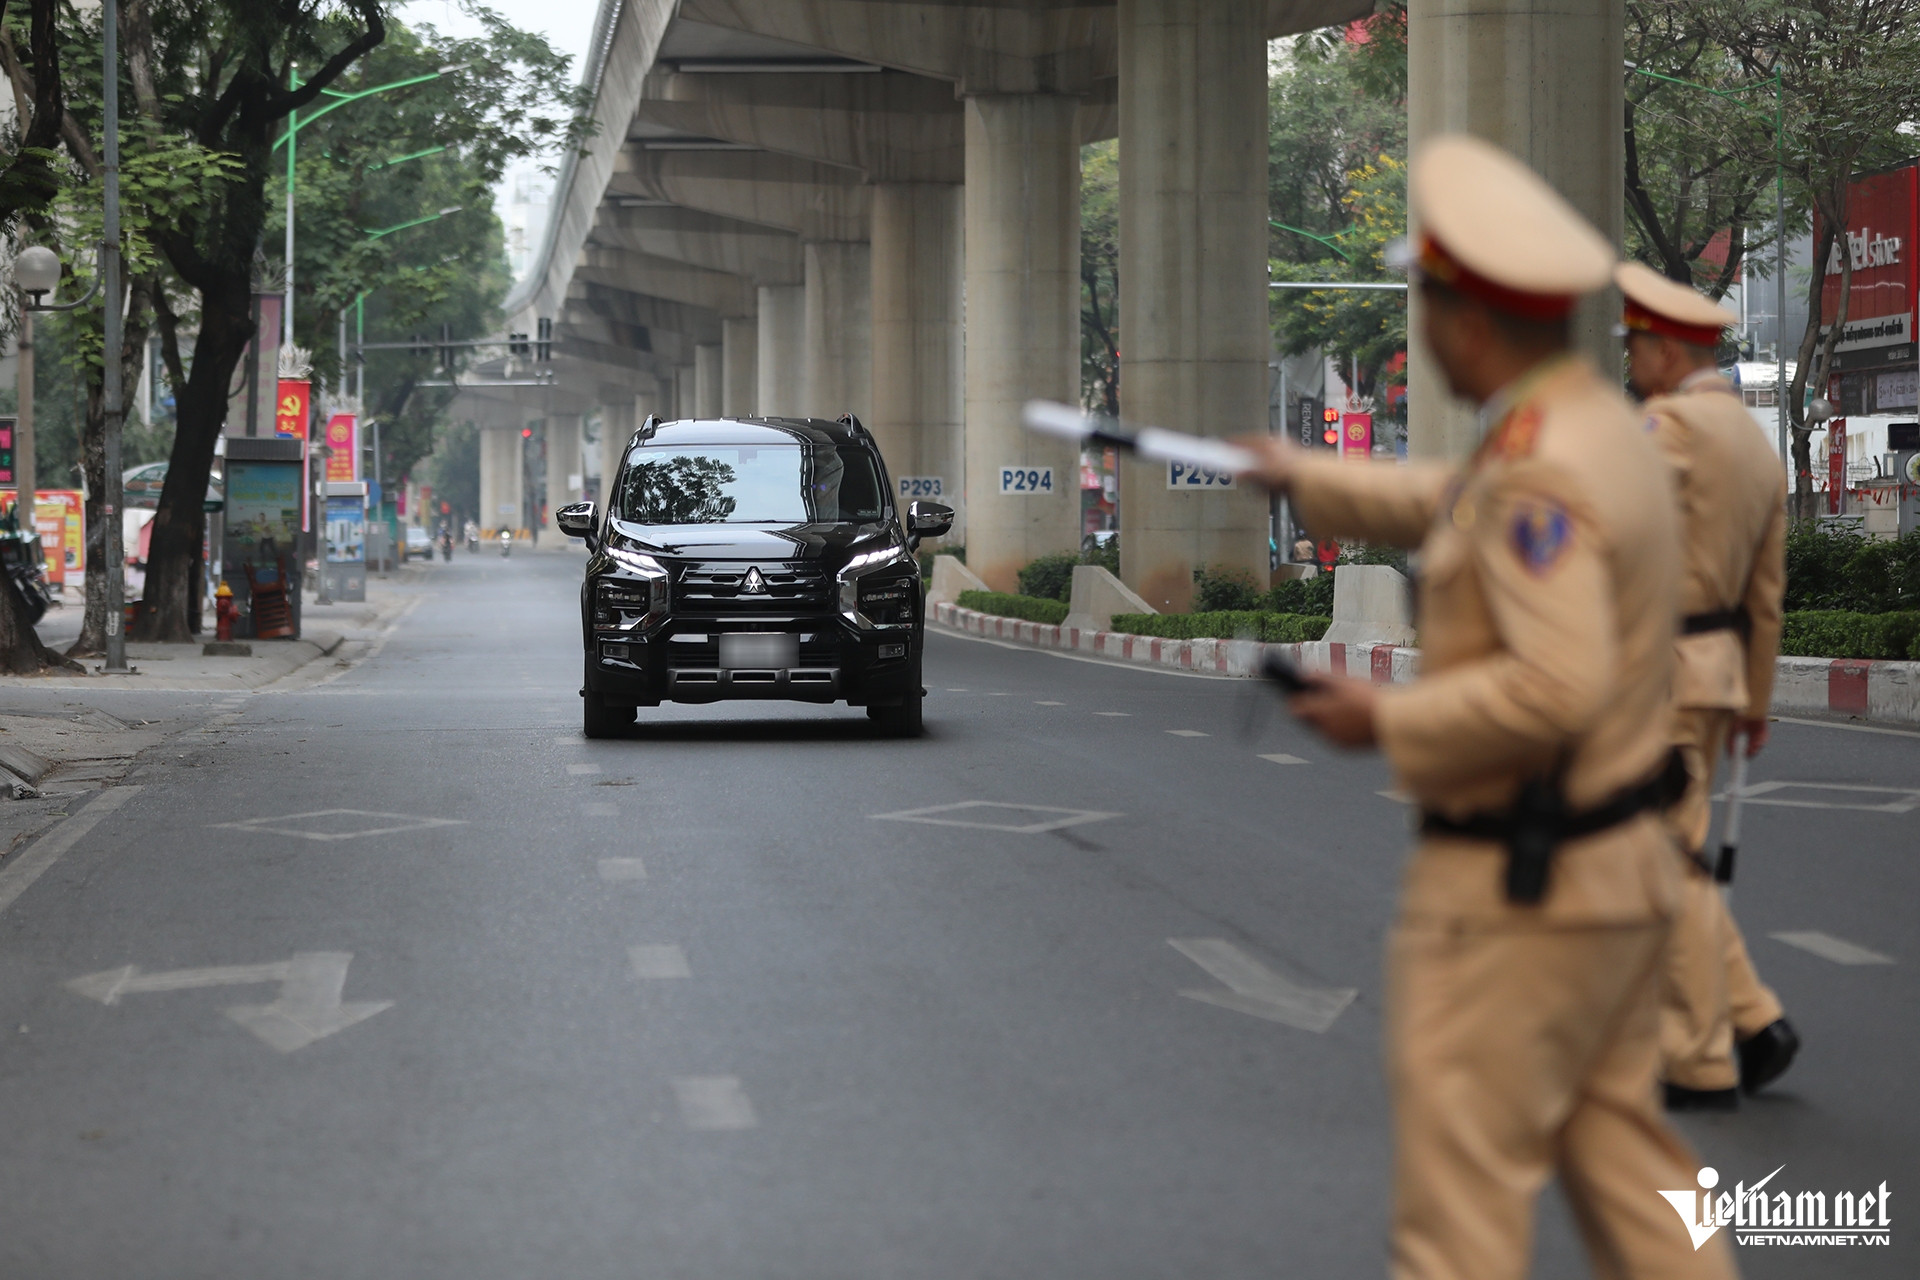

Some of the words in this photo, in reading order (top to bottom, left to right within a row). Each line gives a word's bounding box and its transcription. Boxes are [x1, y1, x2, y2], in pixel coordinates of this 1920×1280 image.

[1869, 232, 1902, 268] store
[1325, 411, 1337, 422] 07
[900, 479, 942, 496] P293
[1003, 470, 1052, 491] P294
